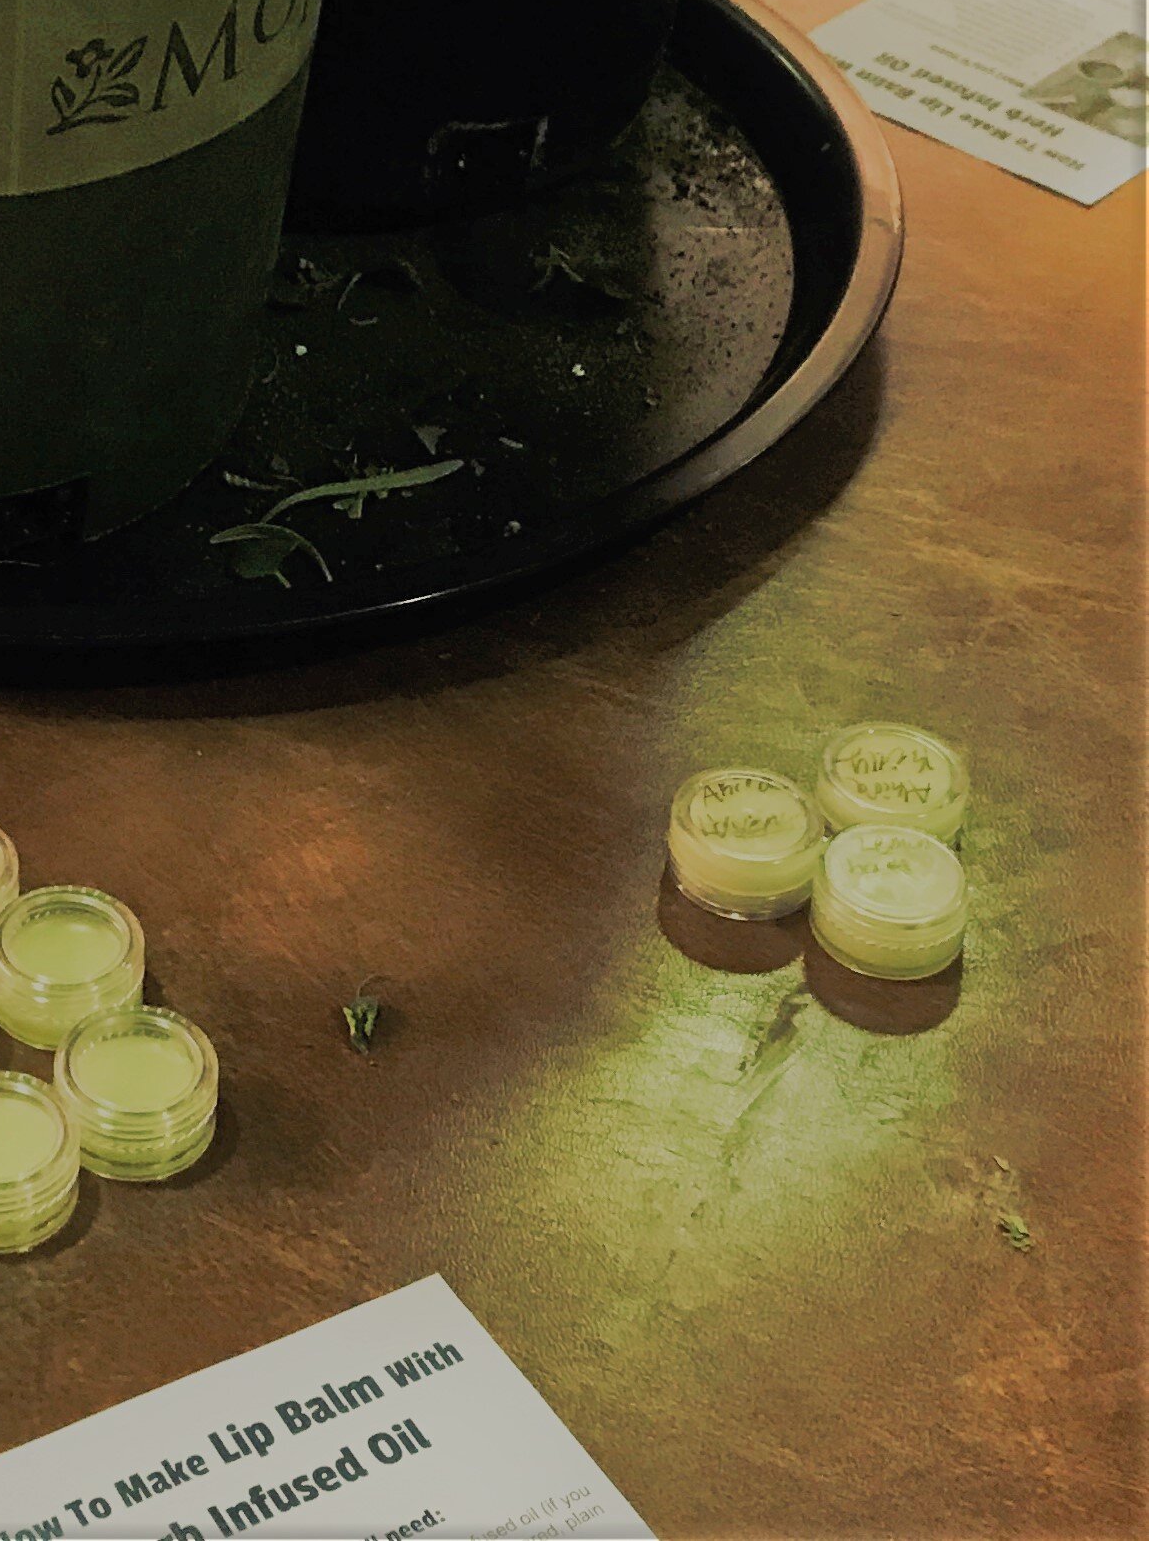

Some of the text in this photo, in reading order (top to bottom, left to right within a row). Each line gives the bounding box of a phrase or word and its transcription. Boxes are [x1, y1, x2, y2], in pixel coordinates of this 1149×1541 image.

[64, 1497, 112, 1527] To
[114, 1459, 210, 1508] Make
[207, 1422, 276, 1465] Lip
[274, 1374, 385, 1436] Balm
[383, 1342, 465, 1388] With
[207, 1417, 433, 1539] Infused Oil
[519, 1506, 540, 1525] oil
[559, 1485, 592, 1509] you
[564, 1504, 606, 1532] plain
